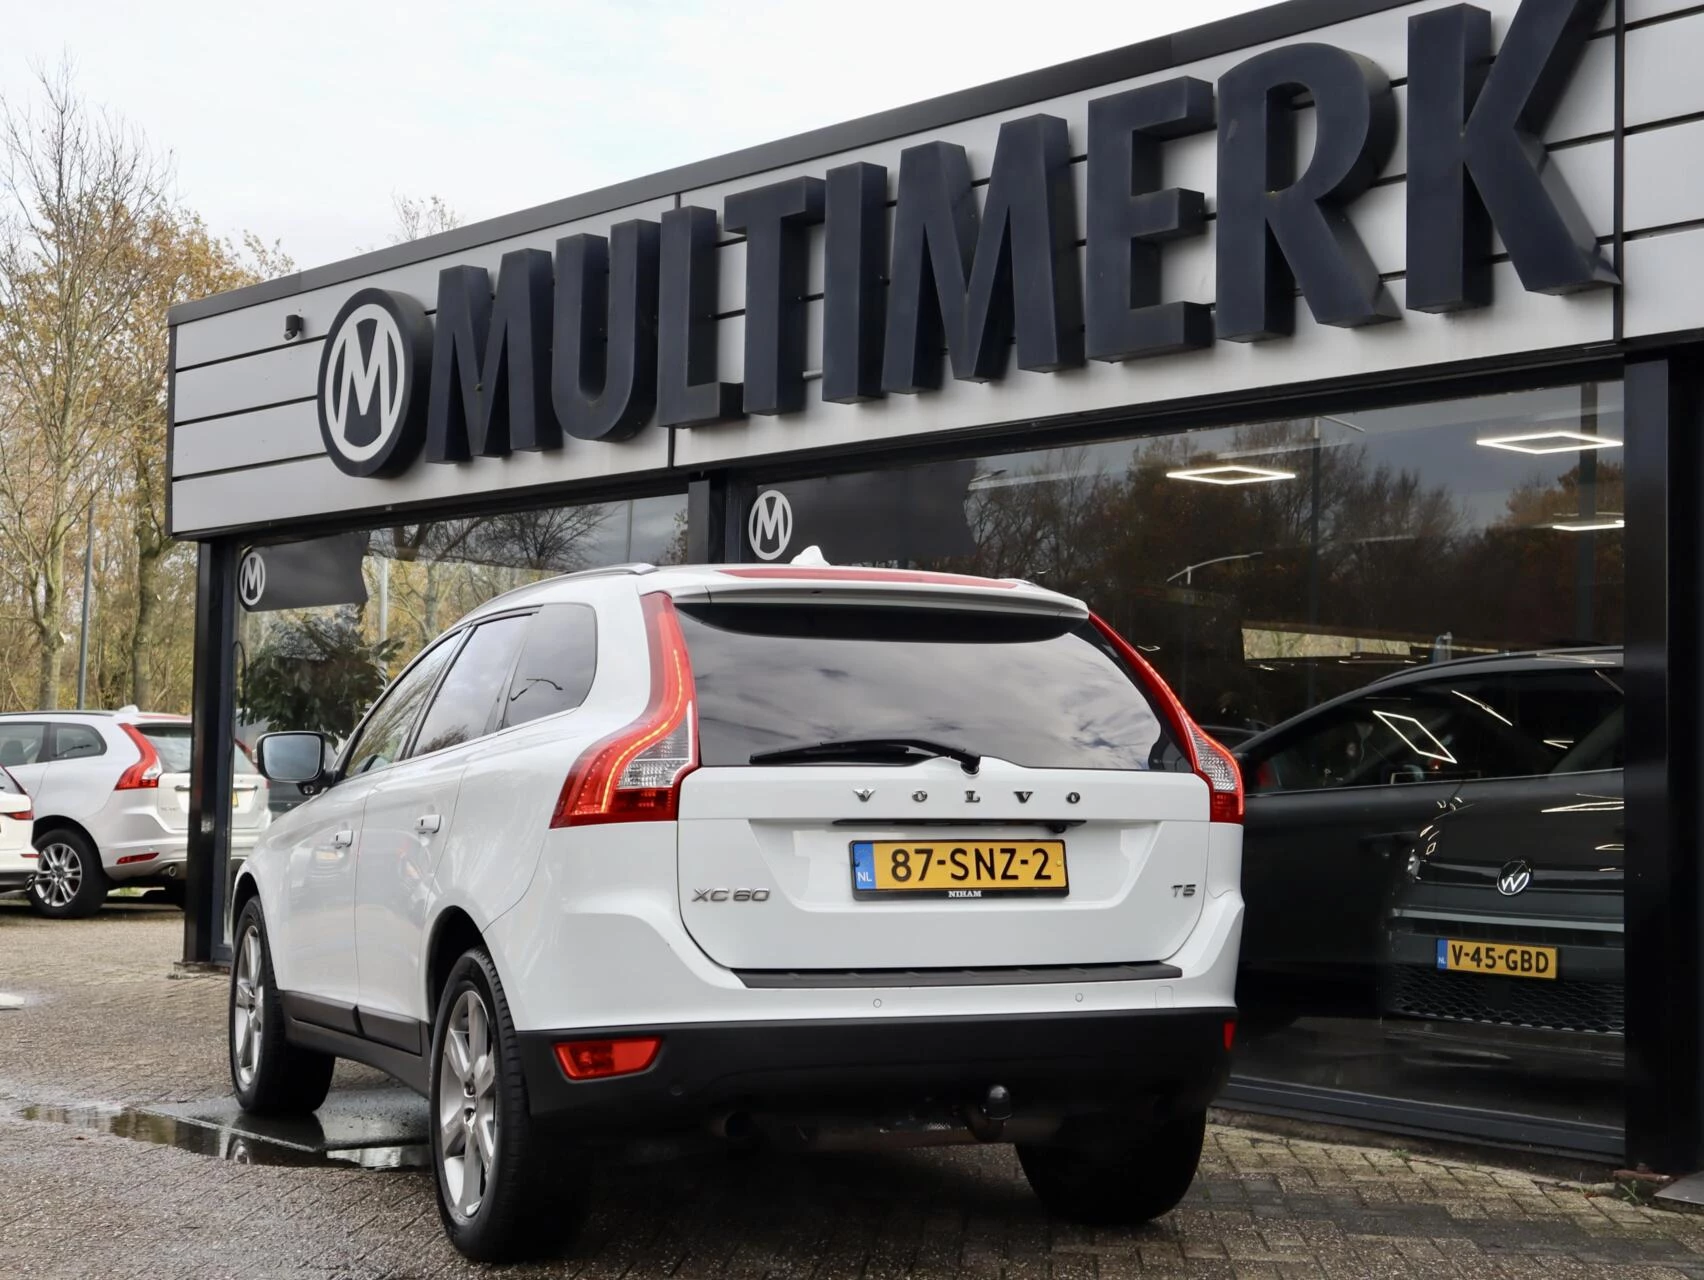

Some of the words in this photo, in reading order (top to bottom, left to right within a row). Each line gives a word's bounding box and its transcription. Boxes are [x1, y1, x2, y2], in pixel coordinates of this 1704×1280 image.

[330, 311, 400, 452] M
[426, 0, 1621, 464] MULTIMERK
[752, 493, 788, 557] M
[241, 555, 263, 602] M
[853, 788, 1081, 805] VOLVO
[857, 871, 873, 882] NL
[890, 847, 1052, 882] 87-SNZ-2
[1171, 884, 1197, 898] T5
[1451, 943, 1549, 974] V-45-GBD
